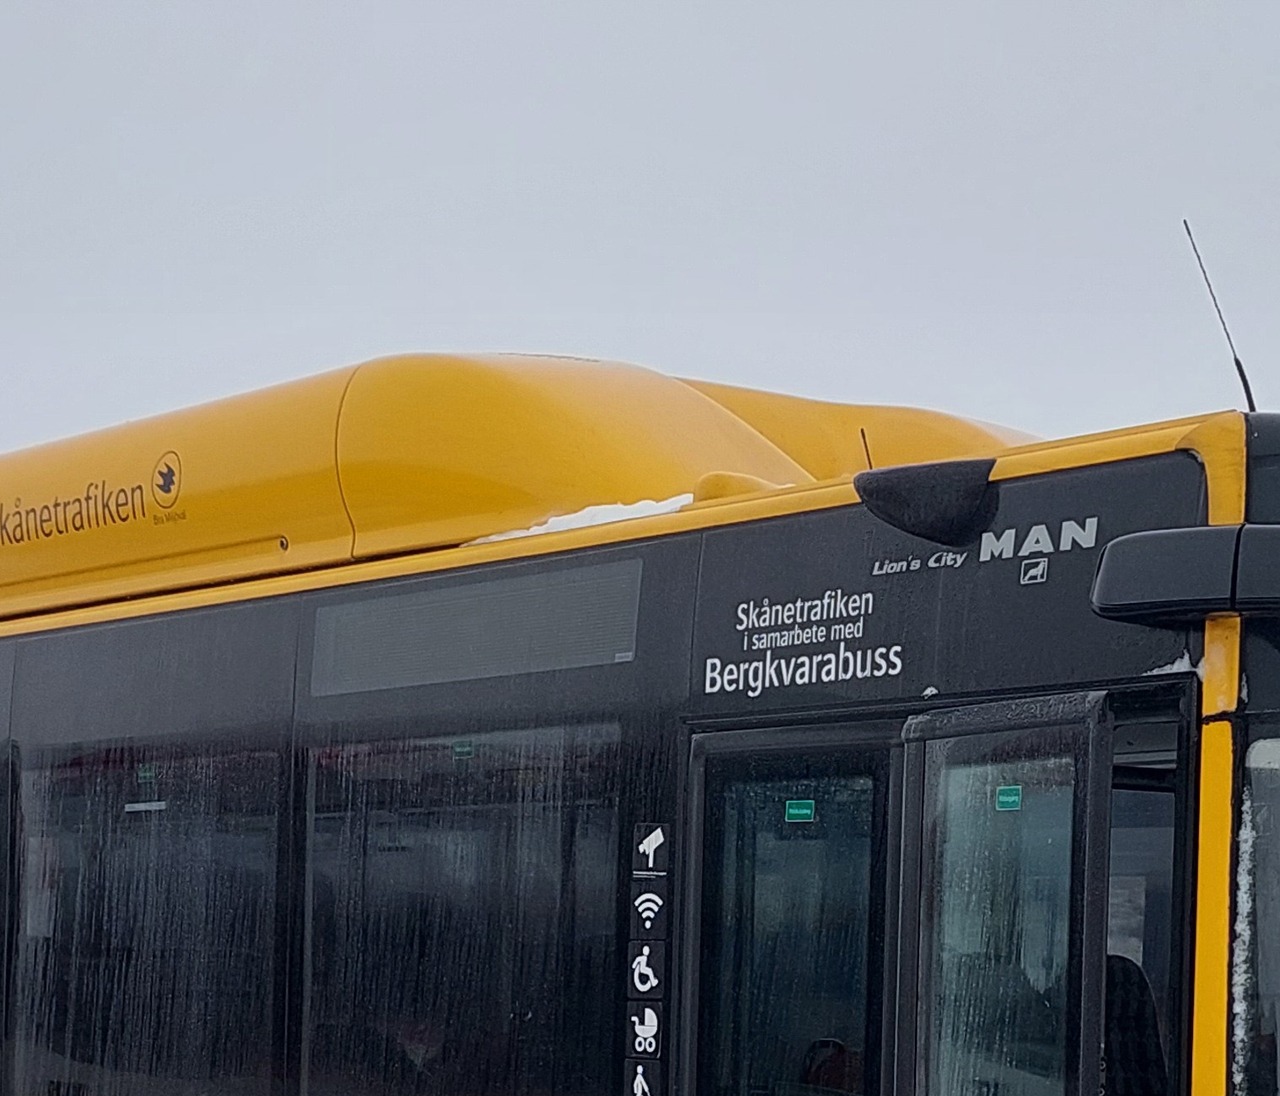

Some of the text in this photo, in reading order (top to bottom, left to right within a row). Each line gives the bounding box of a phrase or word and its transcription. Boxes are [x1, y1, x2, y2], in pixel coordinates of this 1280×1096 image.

[979, 516, 1099, 563] MAN
[871, 551, 968, 576] Lion's City
[735, 588, 874, 632] Skånetrafiken
[743, 615, 864, 651] i samarbete med
[704, 641, 903, 698] Bergkvarabuss
